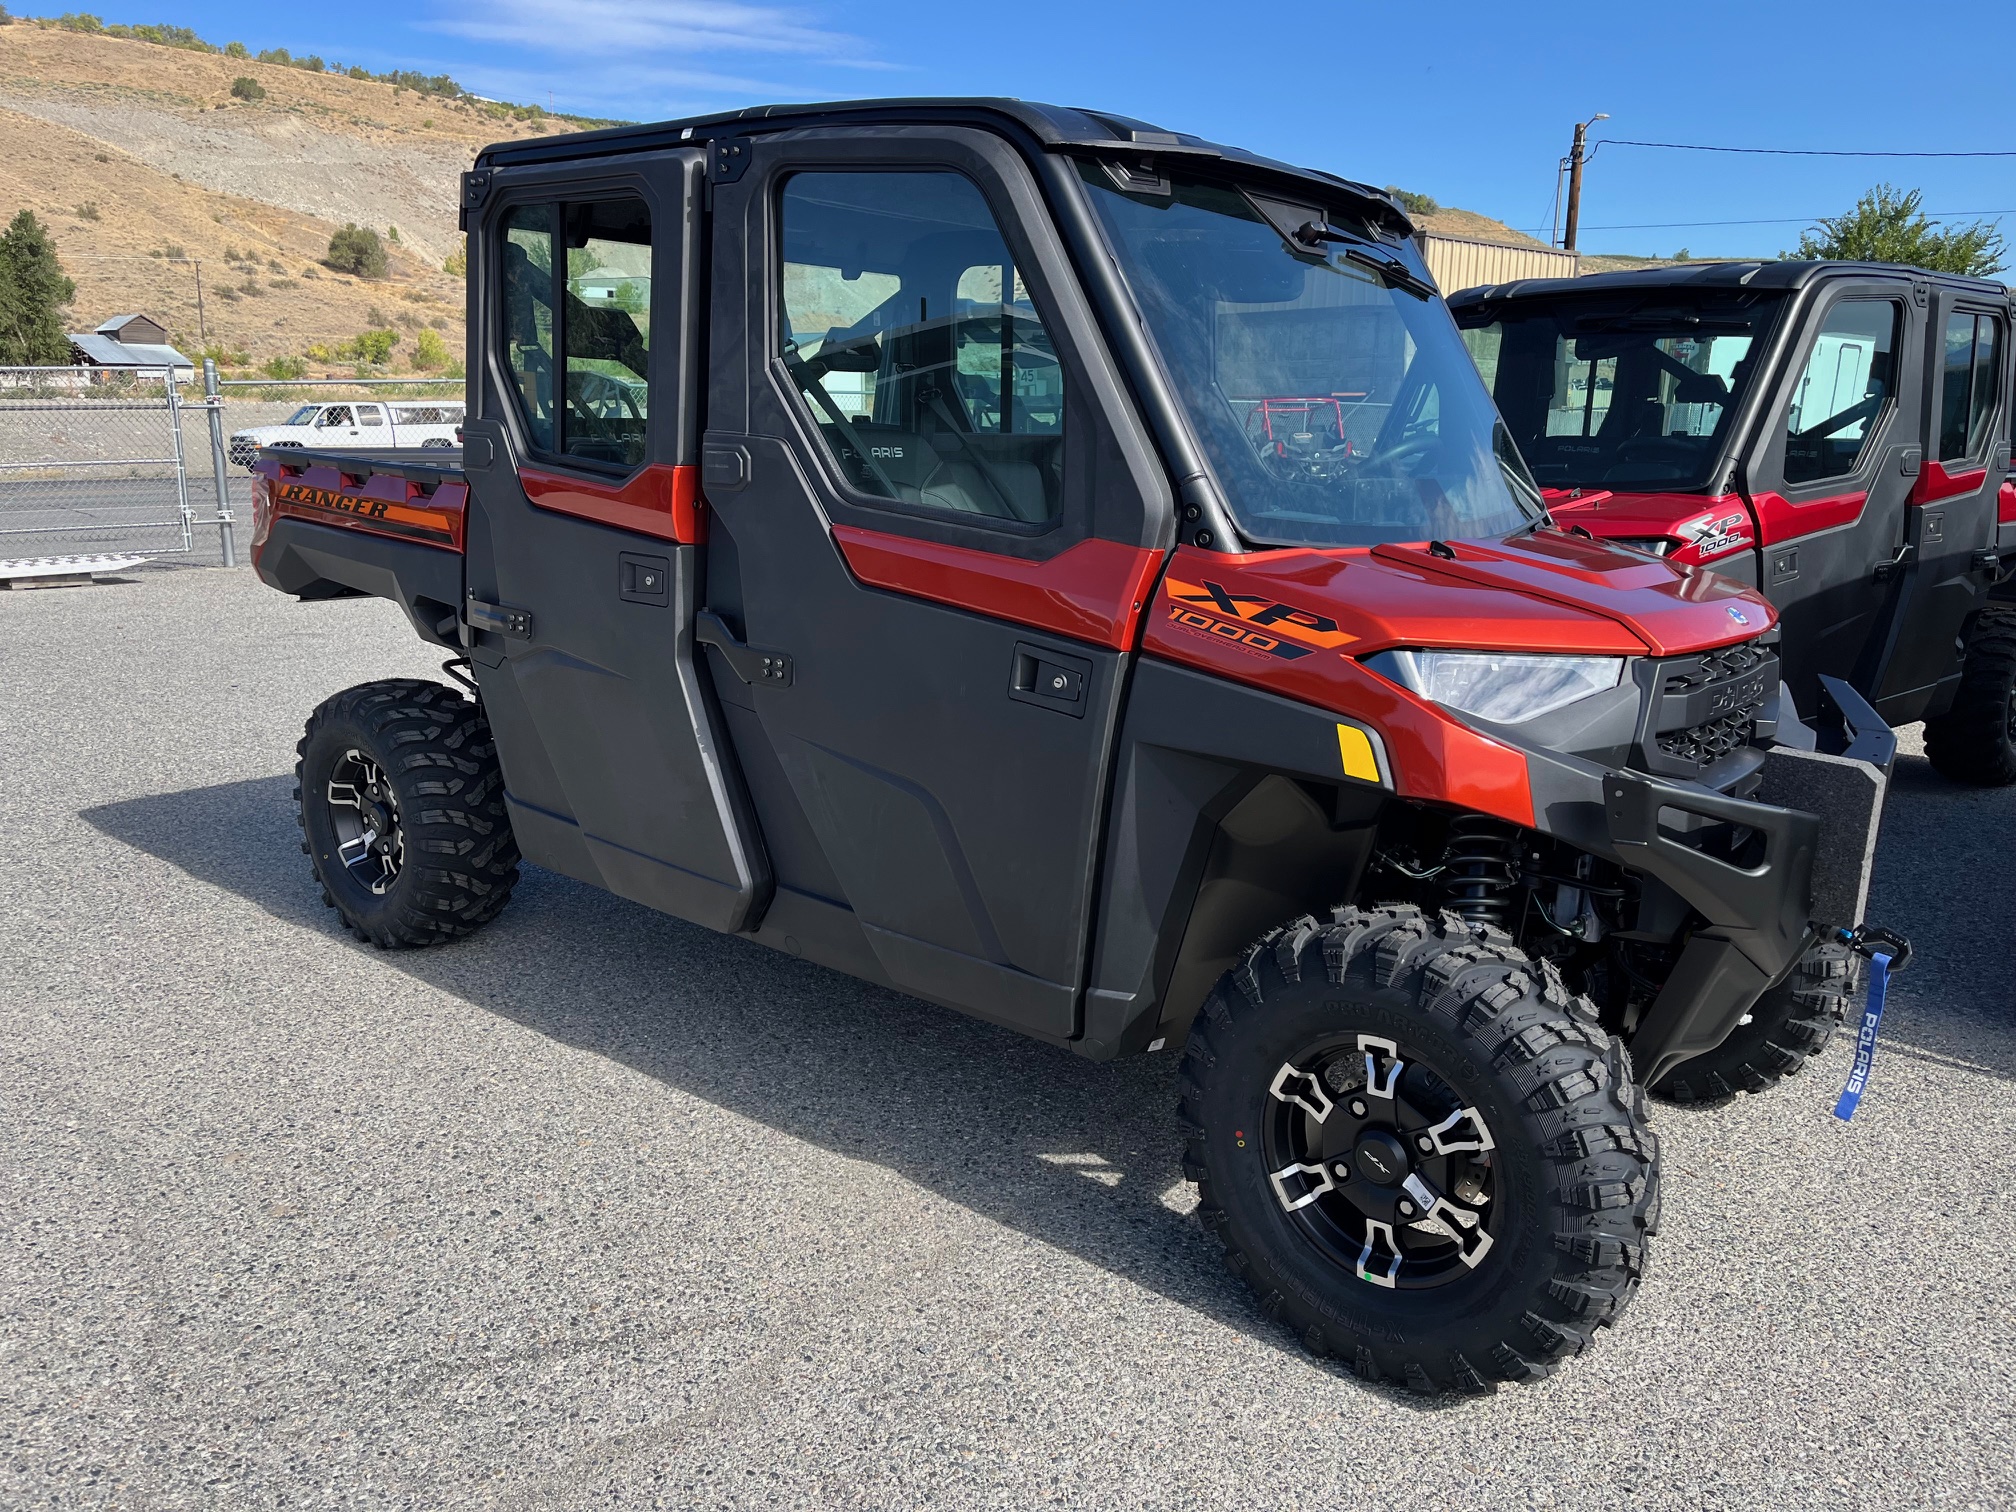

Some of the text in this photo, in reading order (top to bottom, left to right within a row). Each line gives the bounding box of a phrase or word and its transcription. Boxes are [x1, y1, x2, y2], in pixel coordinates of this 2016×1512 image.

[1021, 369, 1035, 382] 45
[285, 484, 389, 519] RANGER
[1690, 513, 1743, 546] XP
[1700, 533, 1740, 554] 1000
[1171, 579, 1339, 633] XP
[1166, 622, 1271, 660] DUAL OVERHEAD CAM
[1167, 607, 1280, 652] 1000
[1847, 1012, 1878, 1094] POLARIS
